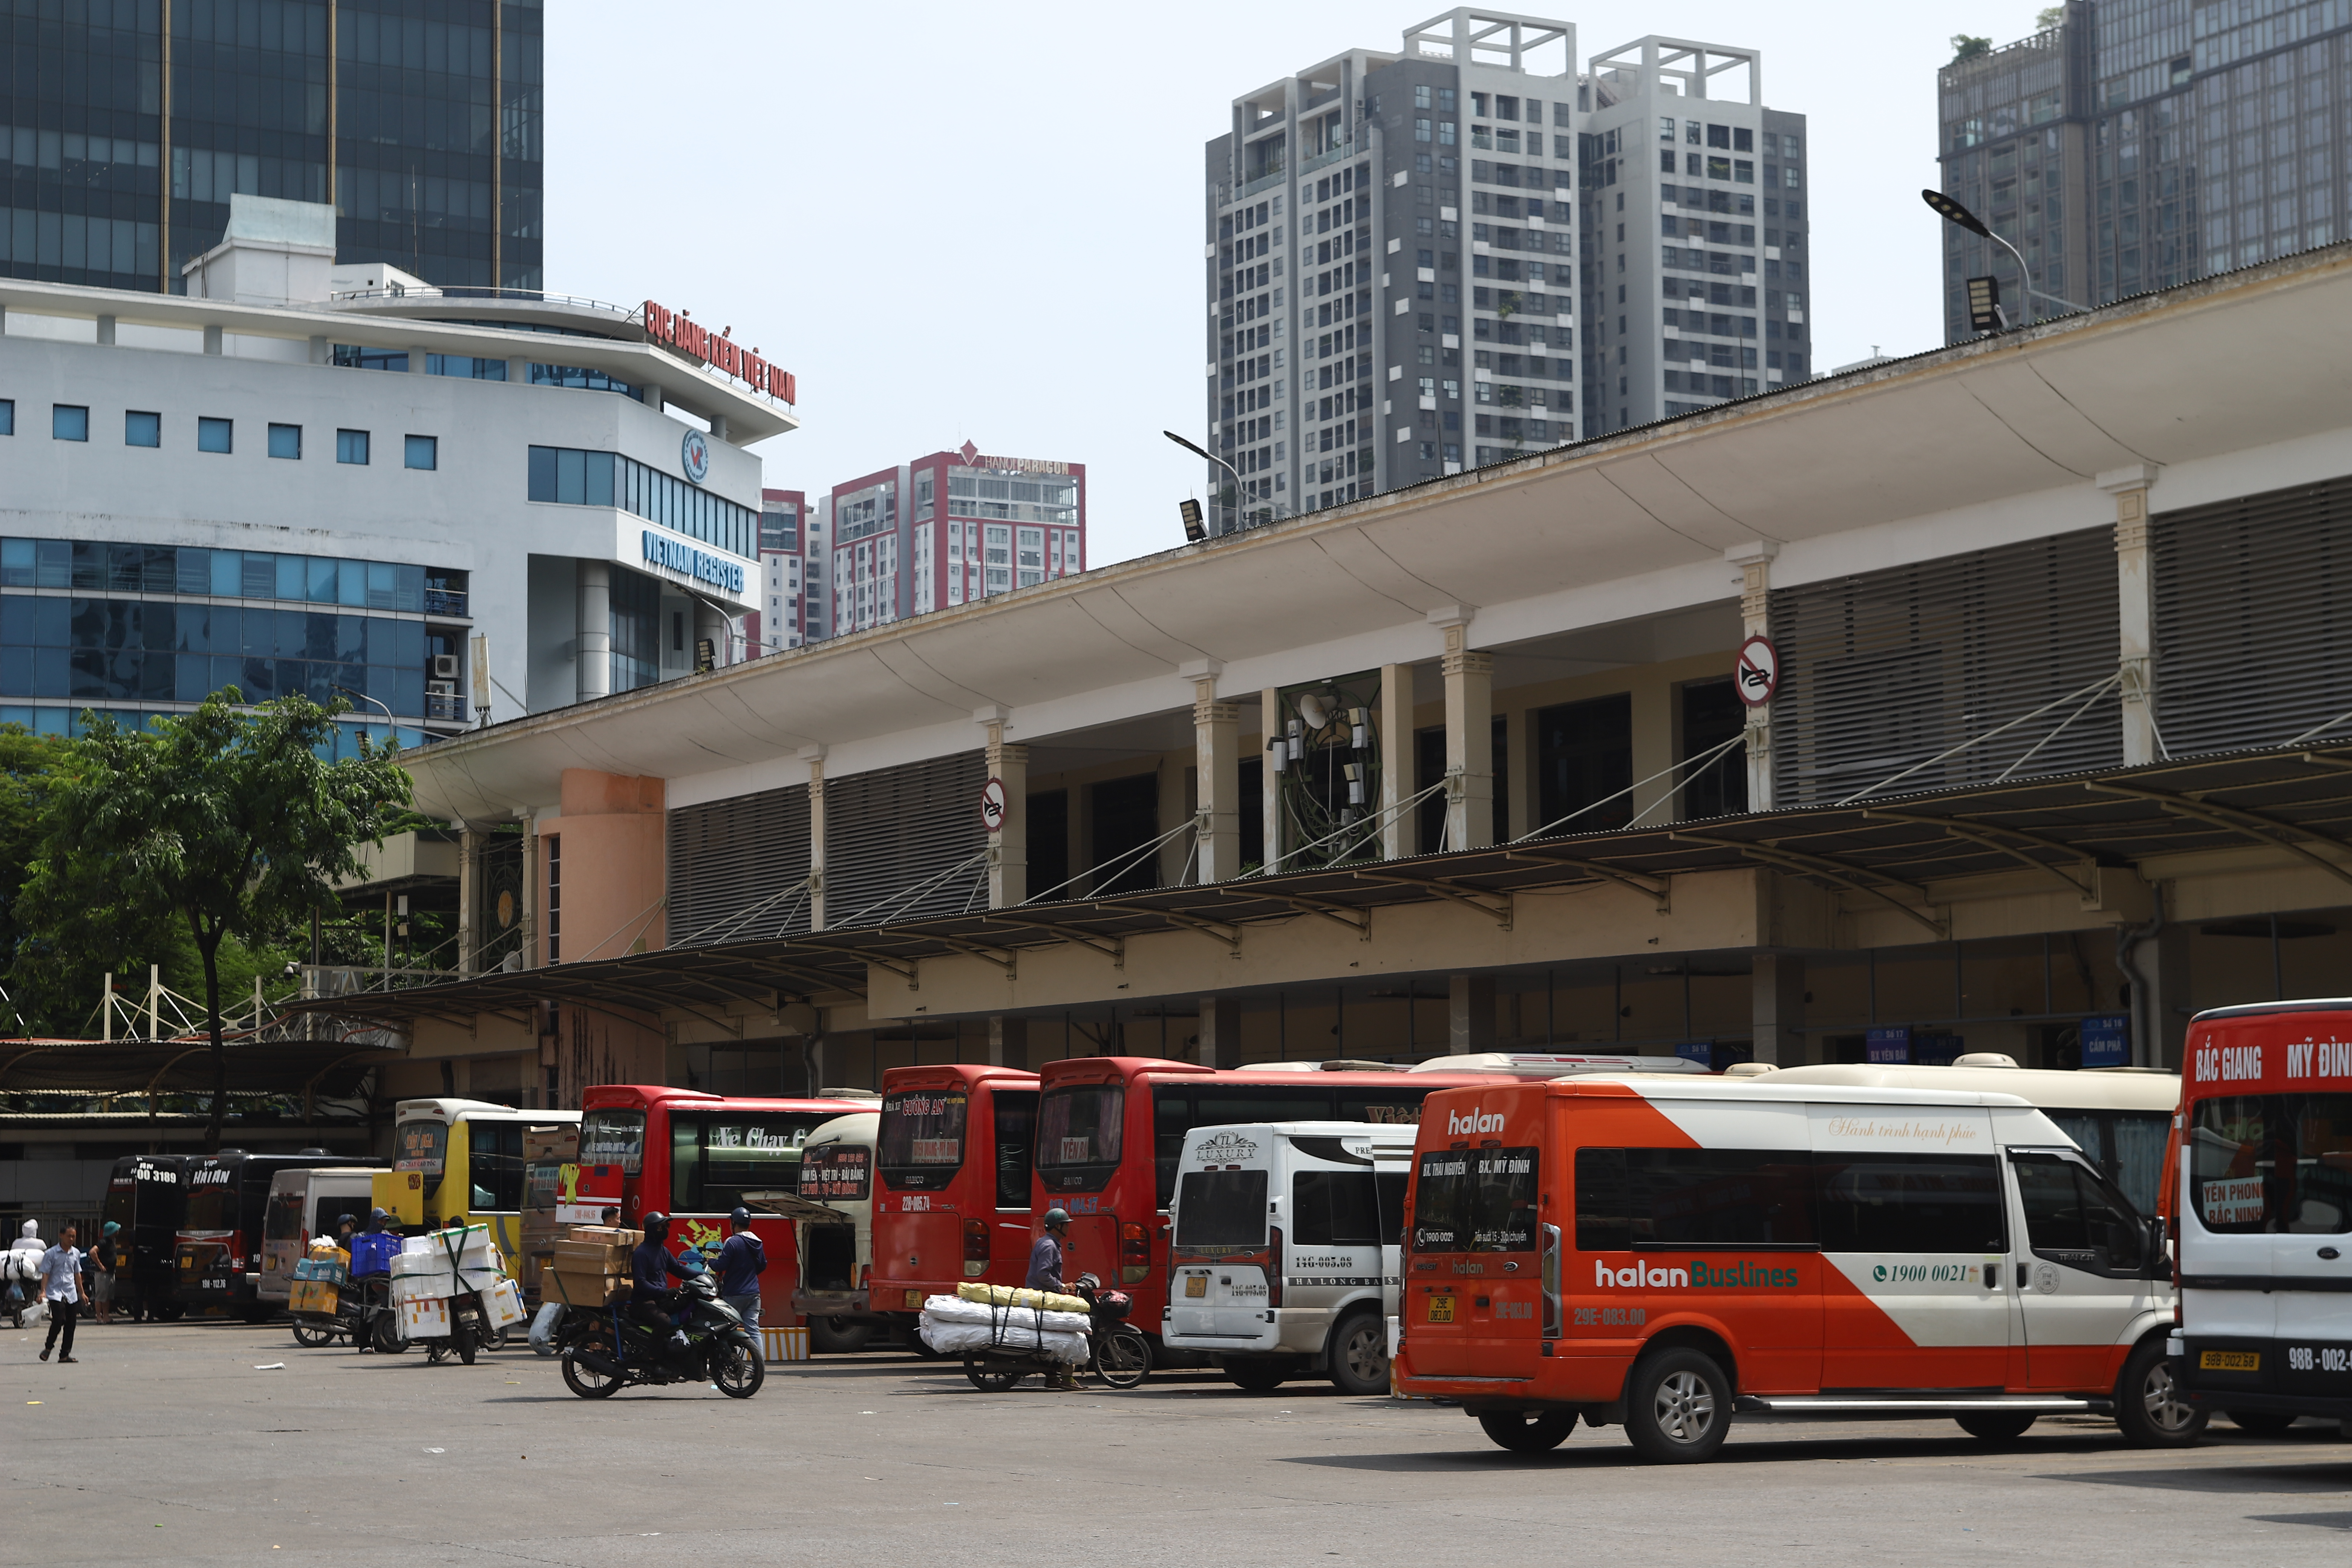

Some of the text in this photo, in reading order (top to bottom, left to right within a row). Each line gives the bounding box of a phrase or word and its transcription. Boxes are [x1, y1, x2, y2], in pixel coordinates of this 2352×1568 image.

[645, 300, 672, 345] CỤC
[674, 309, 709, 361] ĐĂNG
[768, 363, 796, 405] NAM
[1018, 458, 1069, 476] PARAGON
[642, 530, 745, 593] VIETNAM REGISTER
[1896, 1030, 1904, 1038] 17
[1870, 1050, 1880, 1061] BX
[2196, 1035, 2262, 1083] BẮC GIANG
[2287, 1035, 2352, 1078] MỸ ĐÌN
[1448, 1107, 1505, 1135] halan
[717, 1127, 739, 1148] Xe
[1828, 1115, 1977, 1146] Hành trình hạnh phúc
[1063, 1138, 1079, 1159] YÊN
[1220, 1135, 1232, 1145] TL
[1196, 1148, 1256, 1159] LUXURY
[1423, 1158, 1467, 1177] BX. THÁI NGUYÊN
[1478, 1156, 1530, 1174] BX. MỸ ĐÌNH
[153, 1170, 176, 1184] 3189
[2204, 1182, 2226, 1203] YÊN
[2208, 1202, 2231, 1224] BẮC
[1426, 1232, 1454, 1242] 1900 0021
[1295, 1256, 1352, 1268] 14G-005.08
[1452, 1259, 1484, 1274] halan
[1595, 1259, 1799, 1288] halan Buslines
[1890, 1264, 1967, 1282] 1900 0021
[1231, 1285, 1267, 1297] 14G-005.08
[1436, 1298, 1448, 1308] 29E
[1495, 1302, 1533, 1319] 29E-083.00
[1430, 1310, 1451, 1321] 083.00
[1573, 1307, 1646, 1326] 29E-083.00
[2205, 1353, 2255, 1368] 98B-002.68
